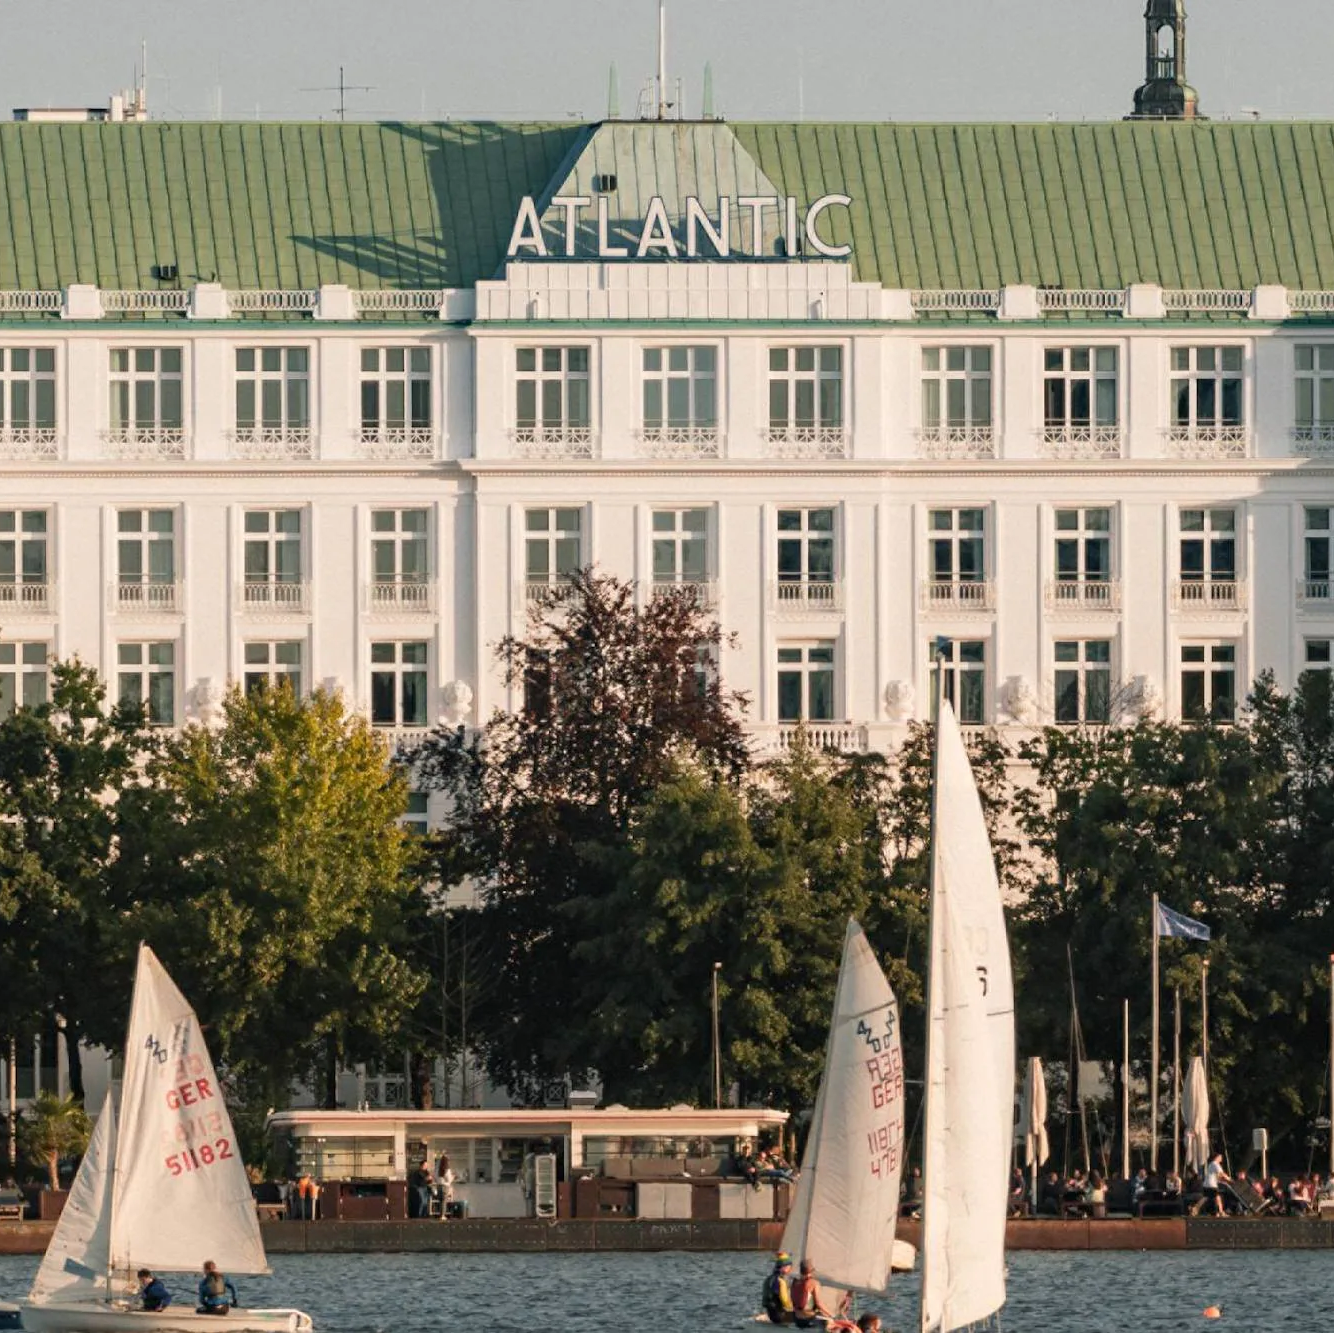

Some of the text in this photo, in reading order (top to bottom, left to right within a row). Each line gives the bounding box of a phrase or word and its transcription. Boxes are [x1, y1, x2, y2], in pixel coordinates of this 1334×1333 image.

[507, 193, 852, 257] ATLANTIC
[166, 1077, 214, 1111] GER
[165, 1138, 234, 1176] 51182
